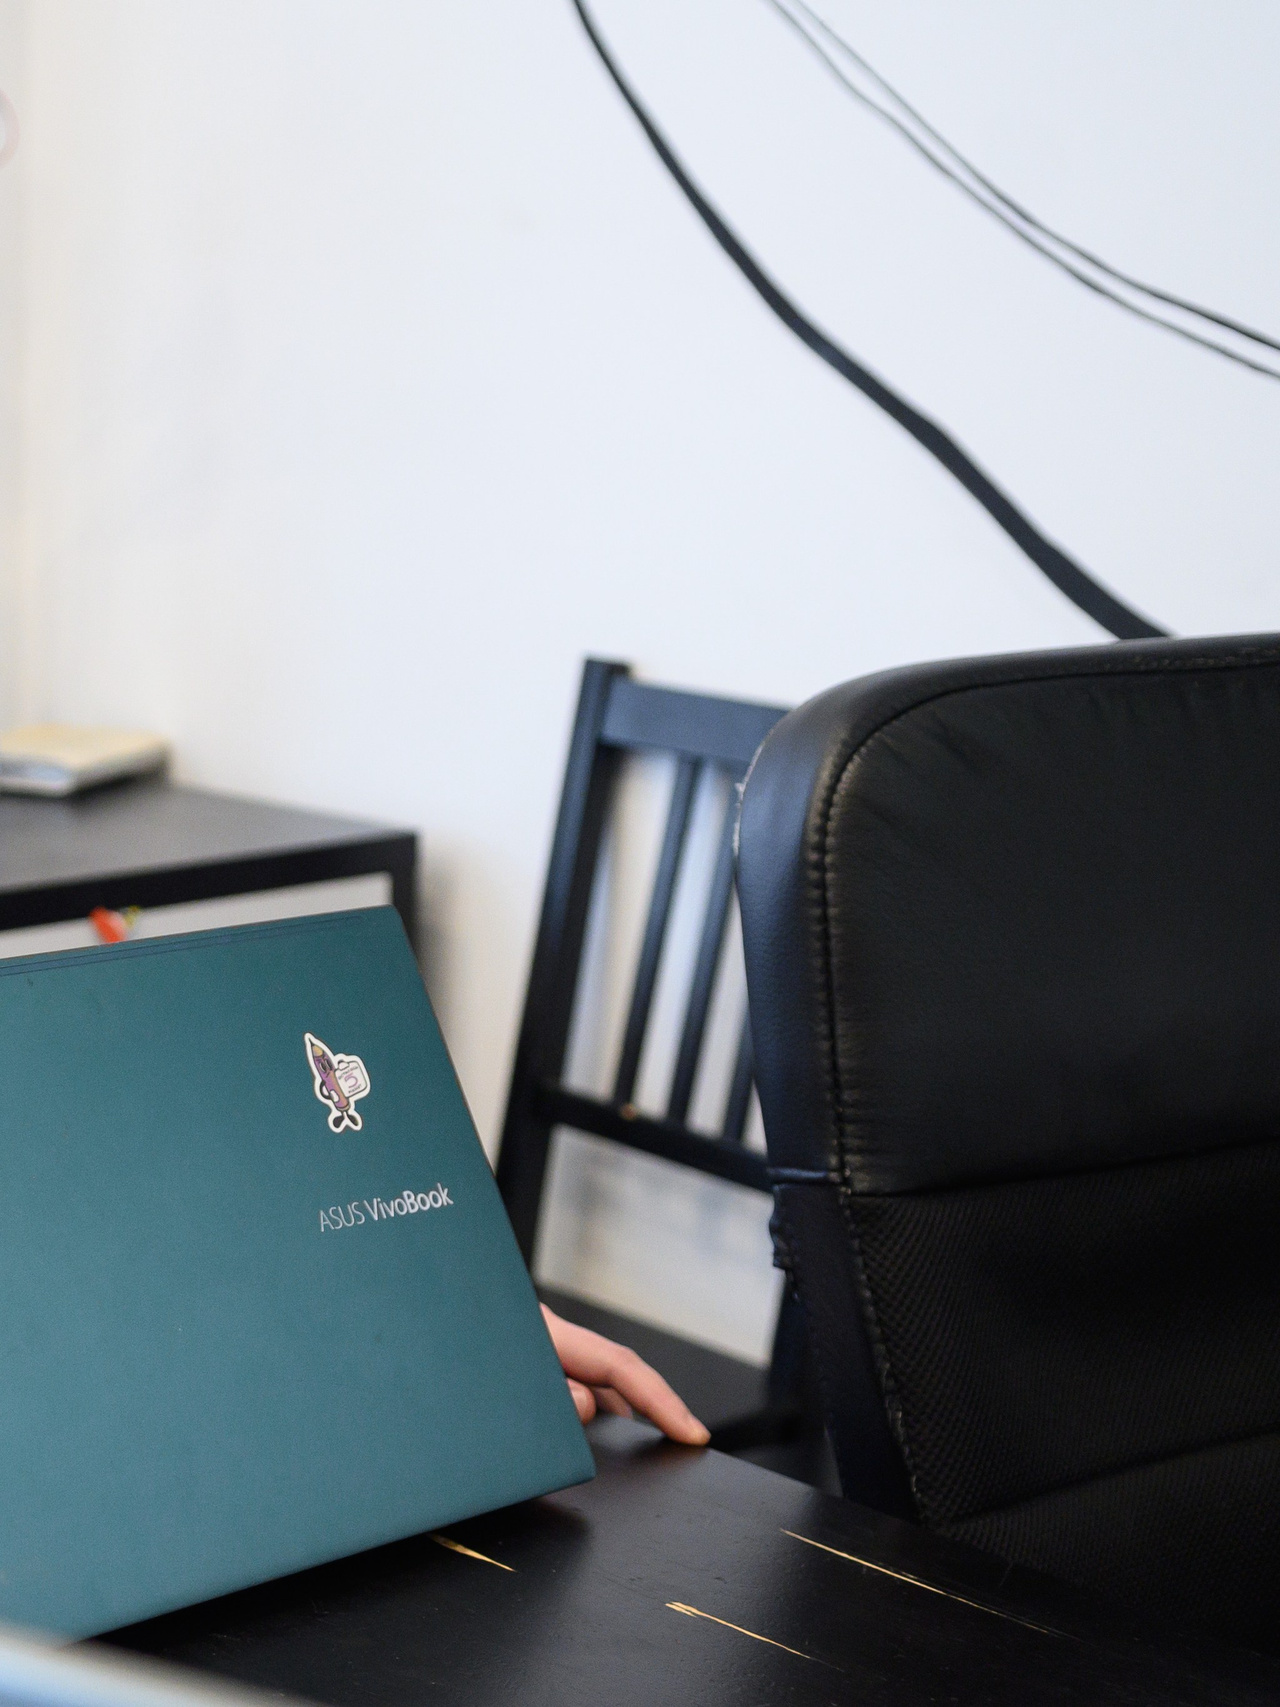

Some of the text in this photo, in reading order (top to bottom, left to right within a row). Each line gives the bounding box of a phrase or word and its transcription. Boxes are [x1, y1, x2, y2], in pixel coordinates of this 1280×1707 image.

[344, 1072, 358, 1088] 5
[320, 1182, 454, 1232] ASUS VivoBook
